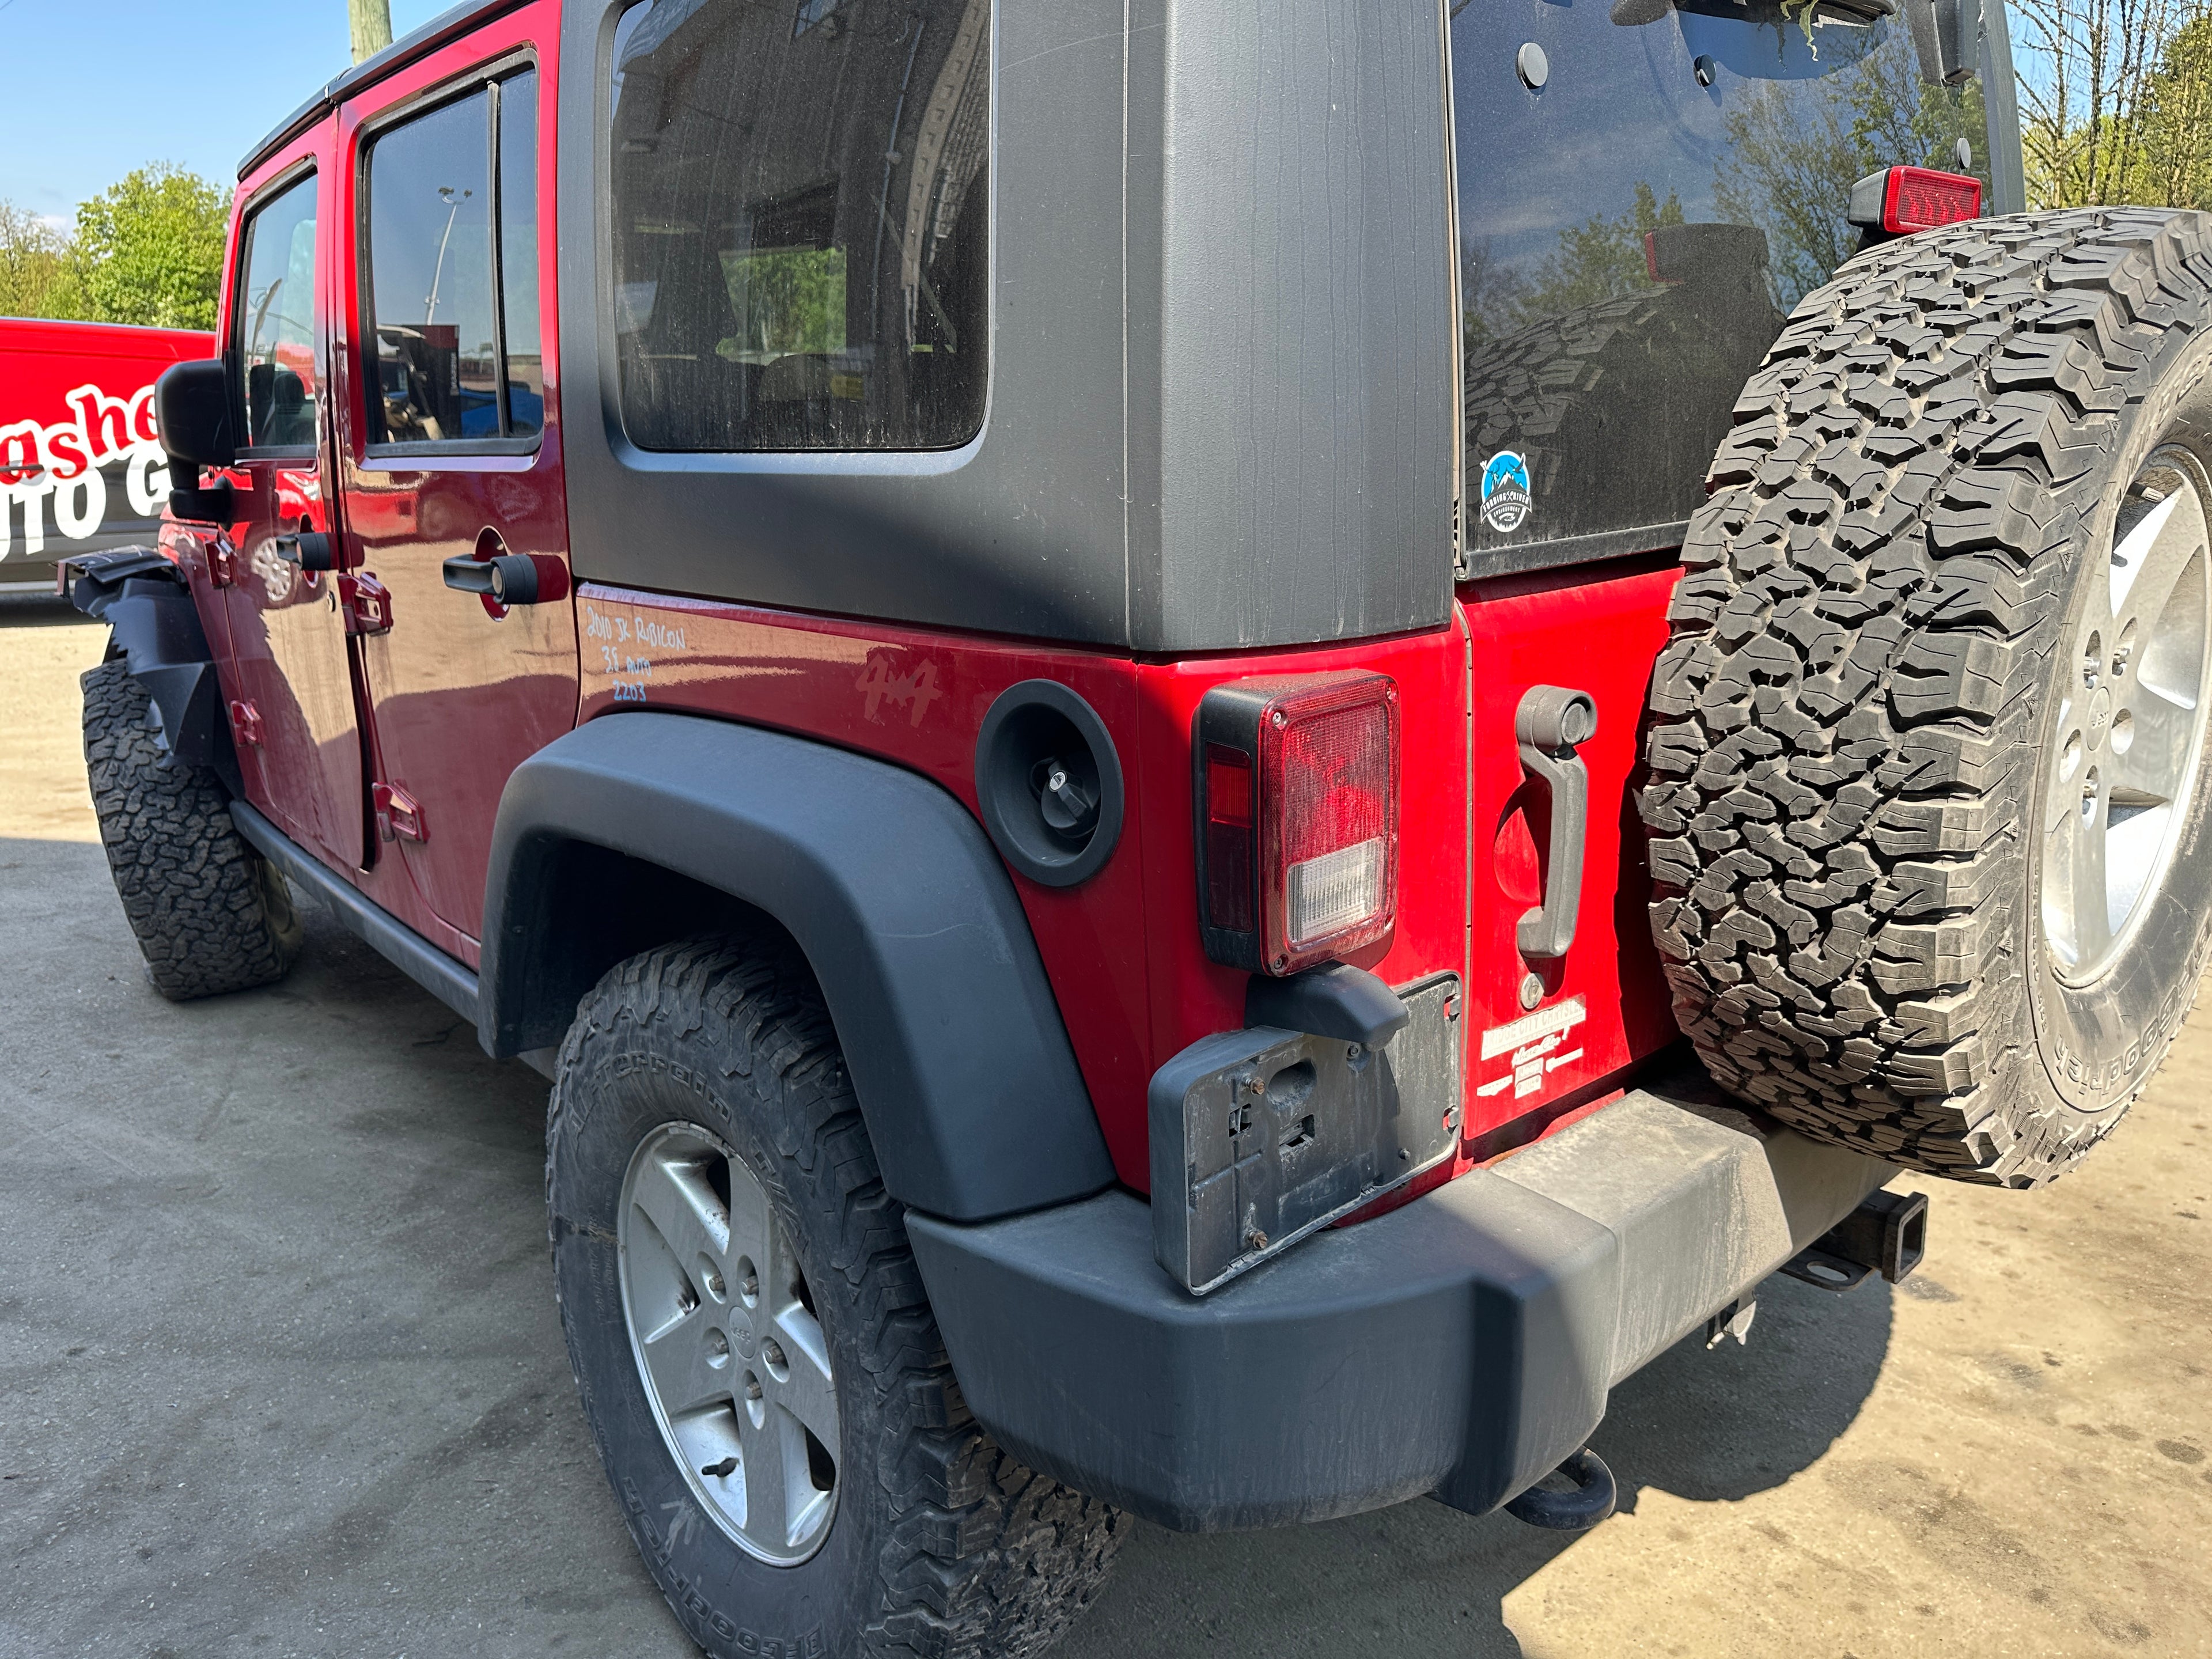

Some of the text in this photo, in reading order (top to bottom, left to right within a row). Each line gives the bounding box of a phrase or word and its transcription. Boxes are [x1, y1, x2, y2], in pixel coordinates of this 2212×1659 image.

[0, 468, 106, 562] TO
[1483, 491, 1529, 513] FORDING RIVER
[587, 606, 612, 641] 2010
[615, 617, 632, 643] JK
[602, 646, 652, 677] 3.8 AUTO
[613, 680, 646, 702] 2203
[1518, 1014, 1540, 1035] CITY
